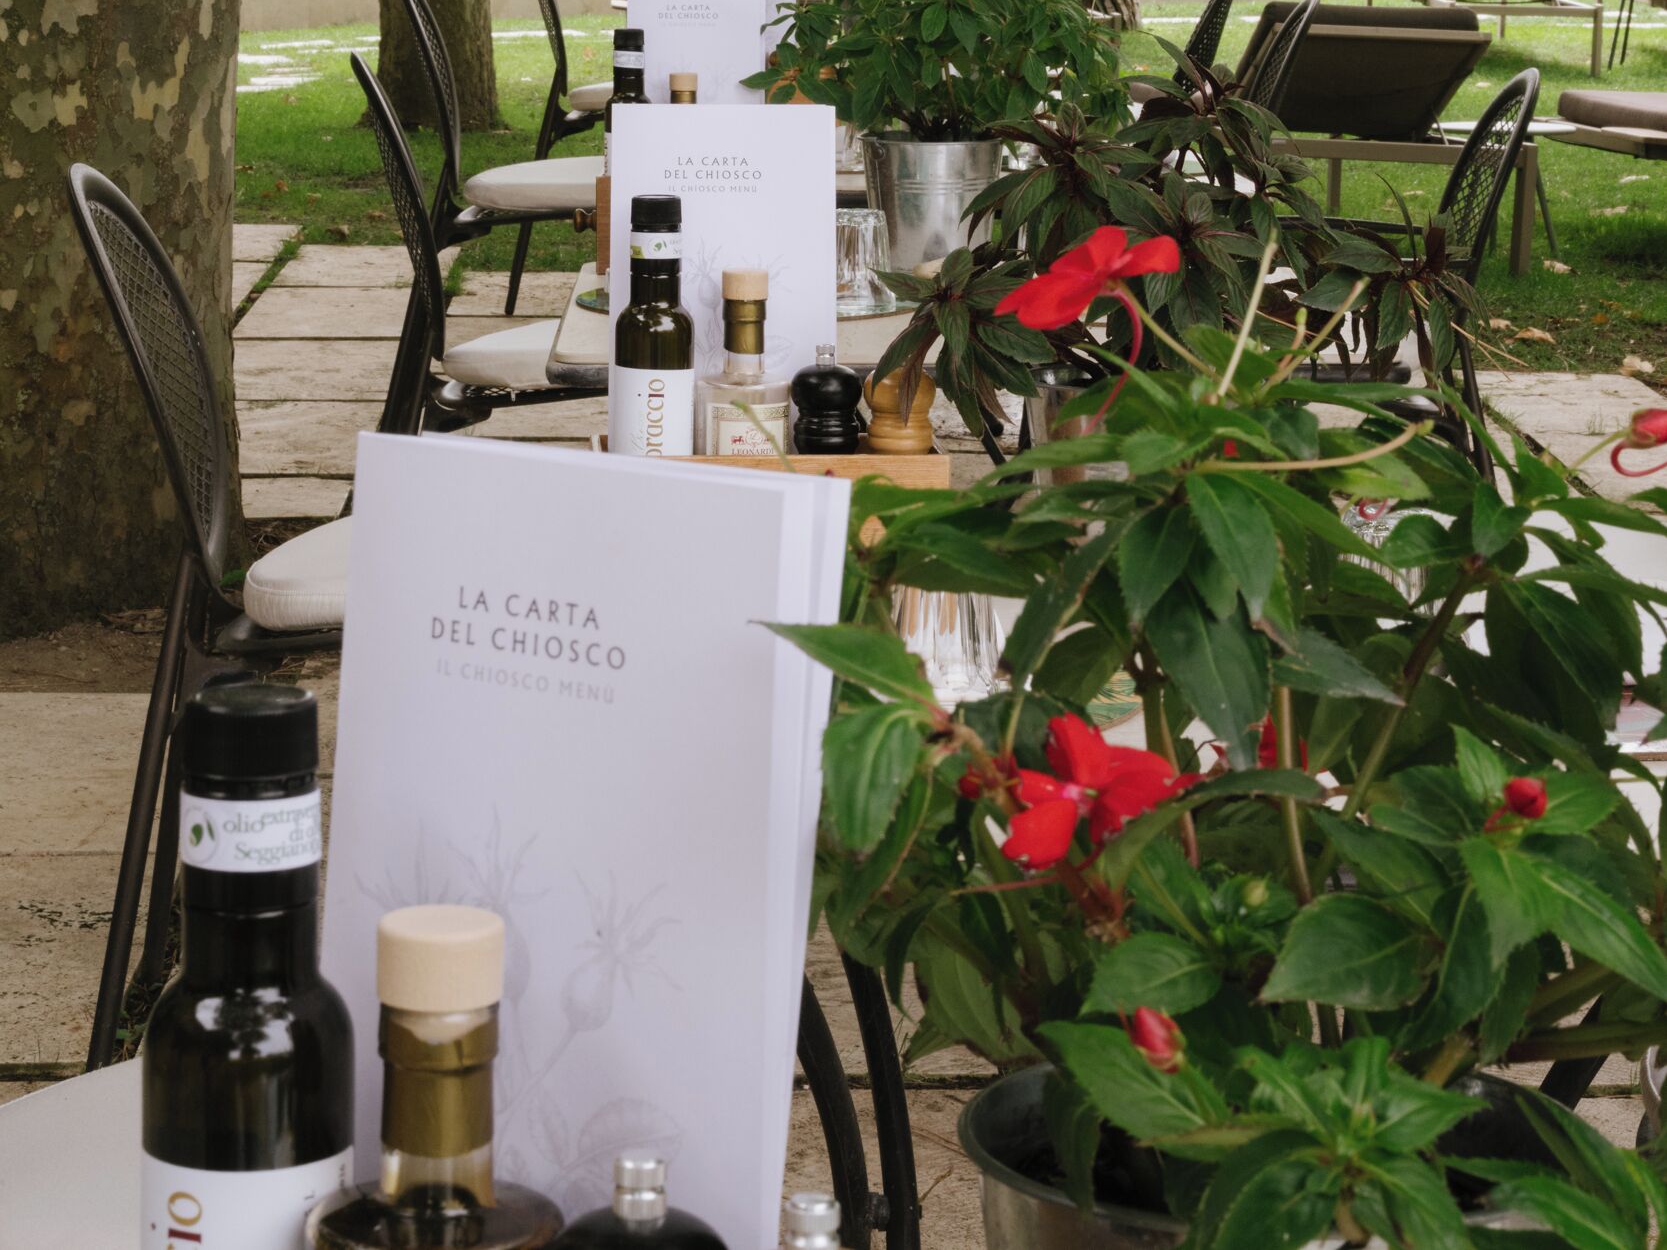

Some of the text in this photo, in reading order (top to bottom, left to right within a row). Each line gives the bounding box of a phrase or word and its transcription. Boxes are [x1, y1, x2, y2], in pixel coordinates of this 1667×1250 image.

[677, 12, 719, 20] CHIOSCO
[681, 3, 711, 12] CARTA
[678, 156, 749, 167] LA CARTA
[664, 169, 762, 180] DEL CHIOSCO
[458, 585, 600, 631] LA CARTA
[431, 616, 626, 671] DEL CHIOSCO
[436, 657, 452, 676] IL
[459, 662, 550, 693] CHIOSCO
[223, 812, 265, 835] olio
